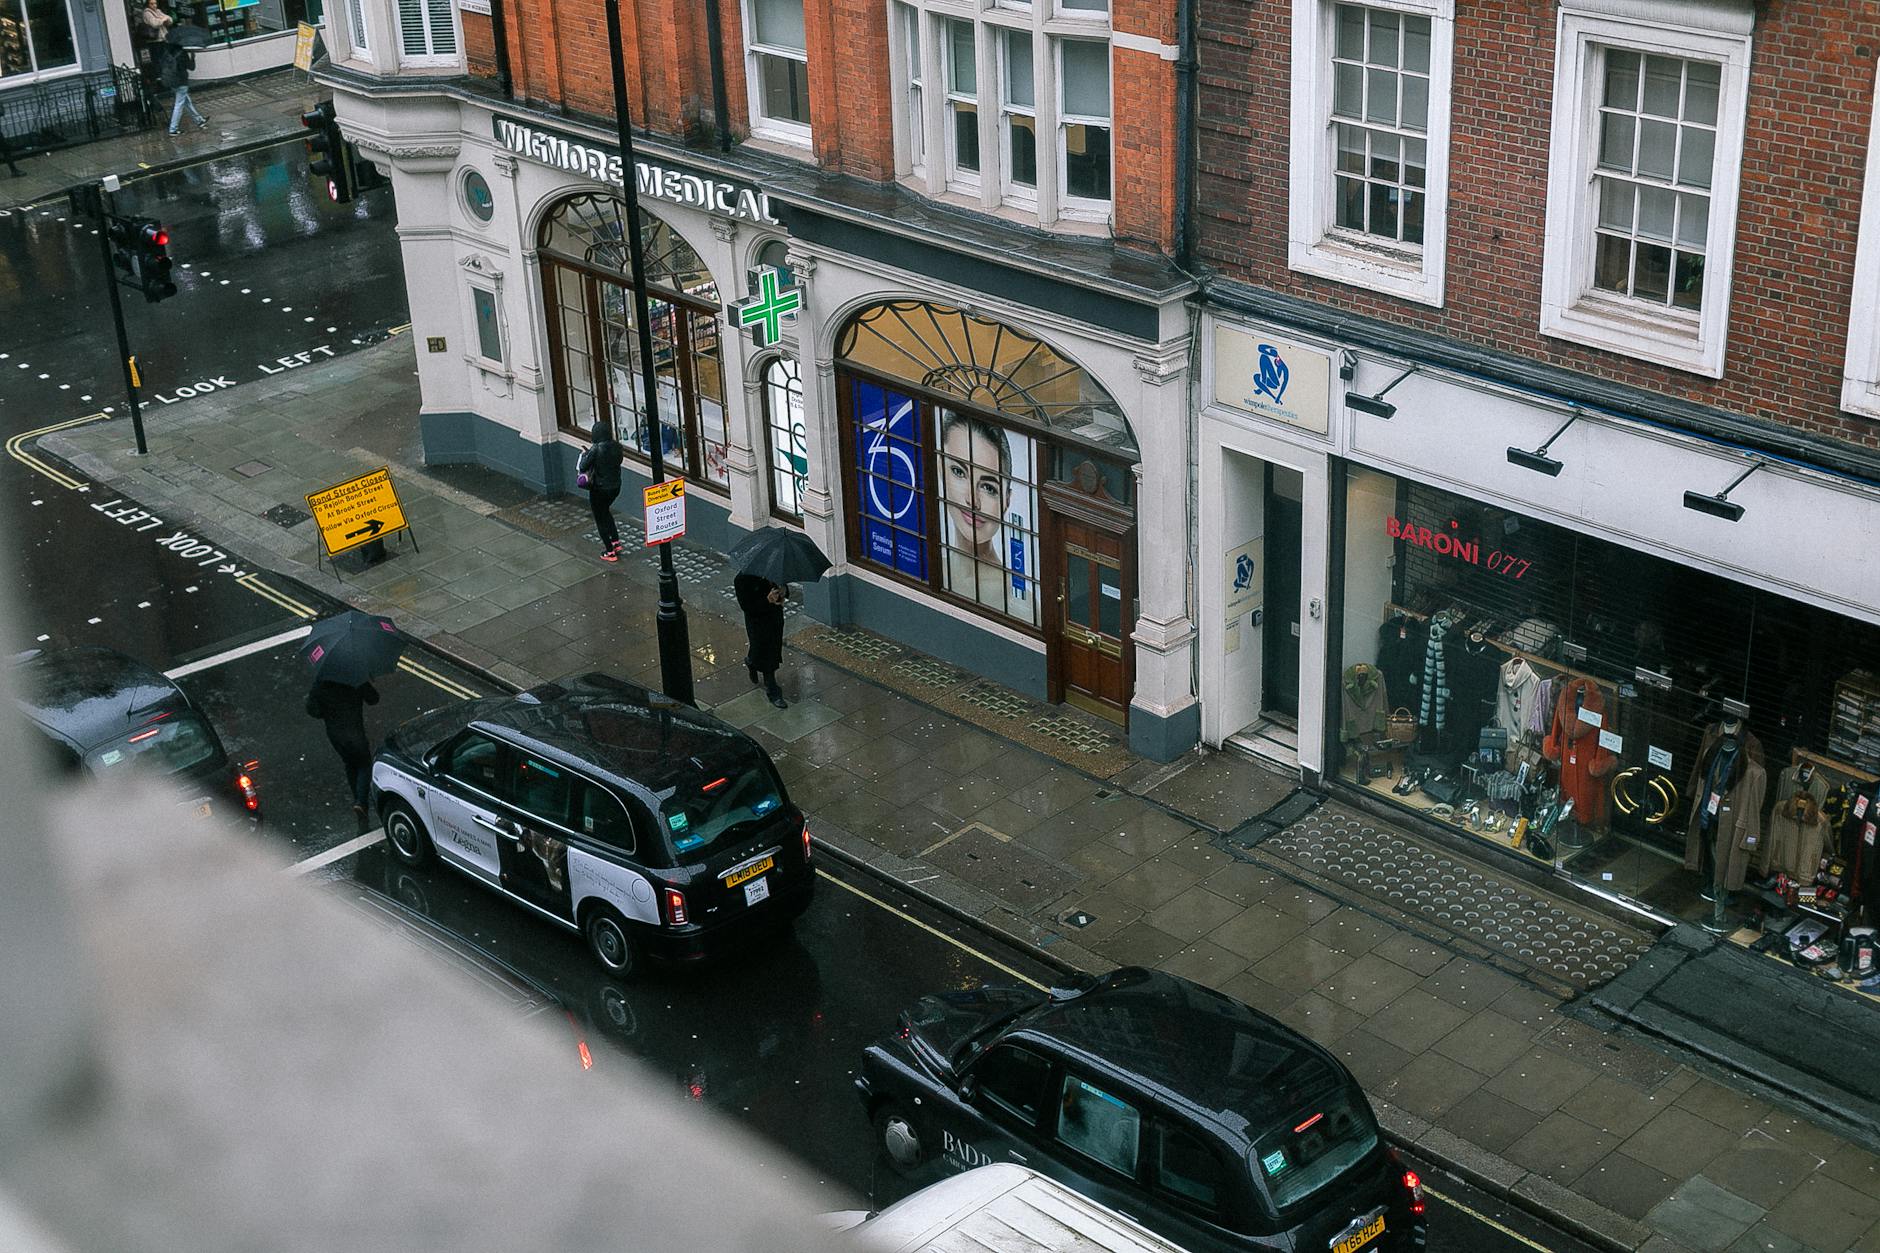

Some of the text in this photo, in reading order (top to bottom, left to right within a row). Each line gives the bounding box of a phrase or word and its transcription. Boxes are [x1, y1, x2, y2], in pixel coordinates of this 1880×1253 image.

[496, 119, 780, 226] WIGMORE MEDICAL
[154, 344, 335, 405] LOOK LEFT
[310, 473, 388, 507] Bond Street Closed
[323, 499, 345, 511] Rejoin
[345, 491, 363, 502] Bond
[364, 484, 384, 495] Street
[648, 493, 669, 503] Diversion
[321, 502, 398, 533] Follow Via Oxford Circus
[327, 496, 377, 519] At Brook Street
[654, 502, 678, 515] Oxford
[656, 512, 677, 523] Street
[90, 499, 227, 567] LOOK LEFT
[655, 520, 678, 531] Routes
[872, 531, 893, 548] Firming
[872, 542, 892, 557] Serum
[1487, 550, 1534, 579] 077
[451, 830, 482, 856] Zegna
[1363, 1222, 1381, 1240] HZF
